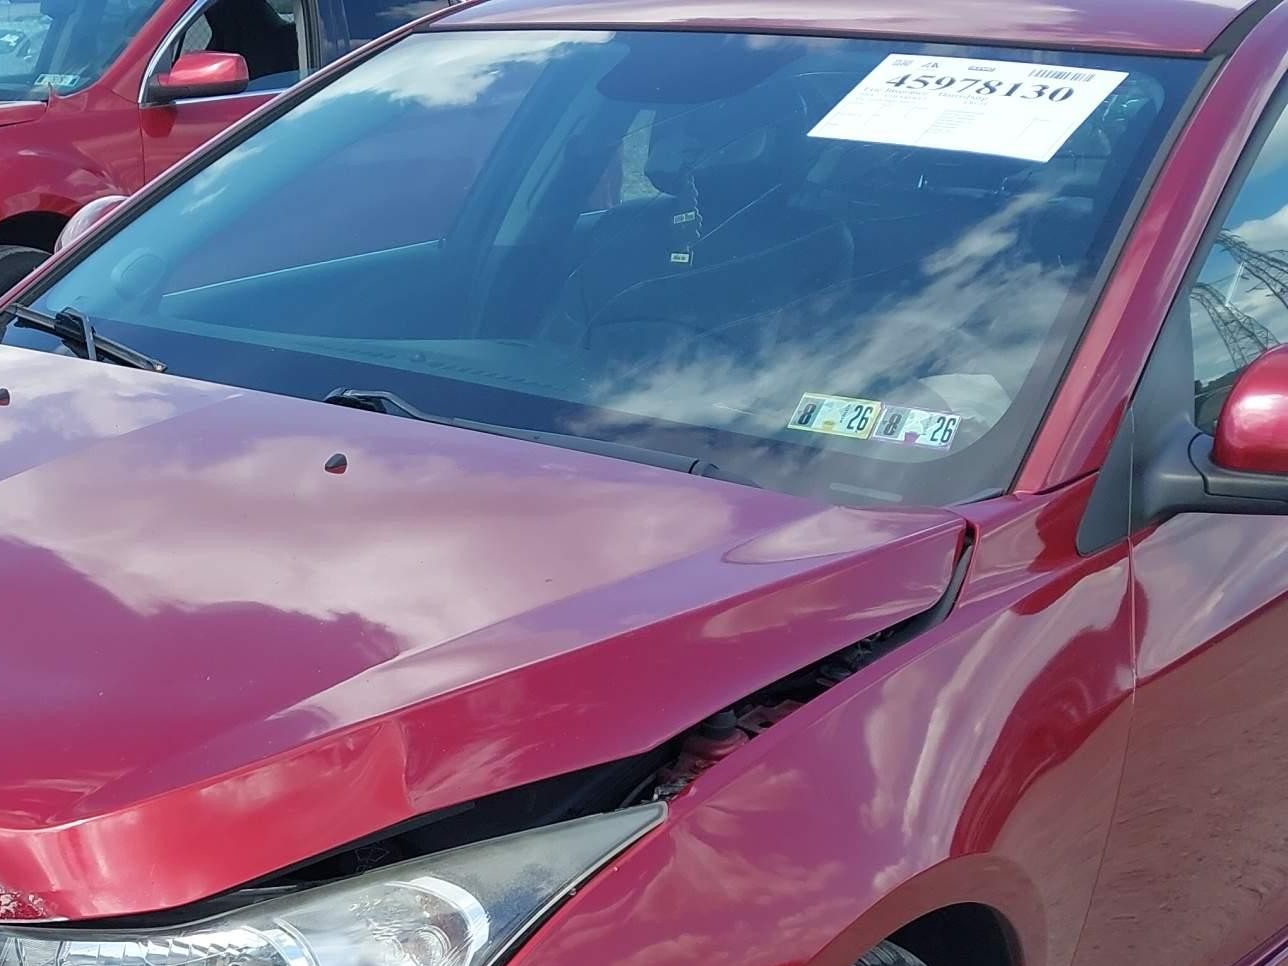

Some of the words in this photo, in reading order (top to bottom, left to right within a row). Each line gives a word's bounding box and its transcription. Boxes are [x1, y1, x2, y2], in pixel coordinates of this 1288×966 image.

[886, 73, 1075, 103] 45978130
[797, 403, 817, 425] 8
[847, 405, 873, 431] 26
[883, 413, 902, 436] 8
[930, 416, 957, 443] 26
